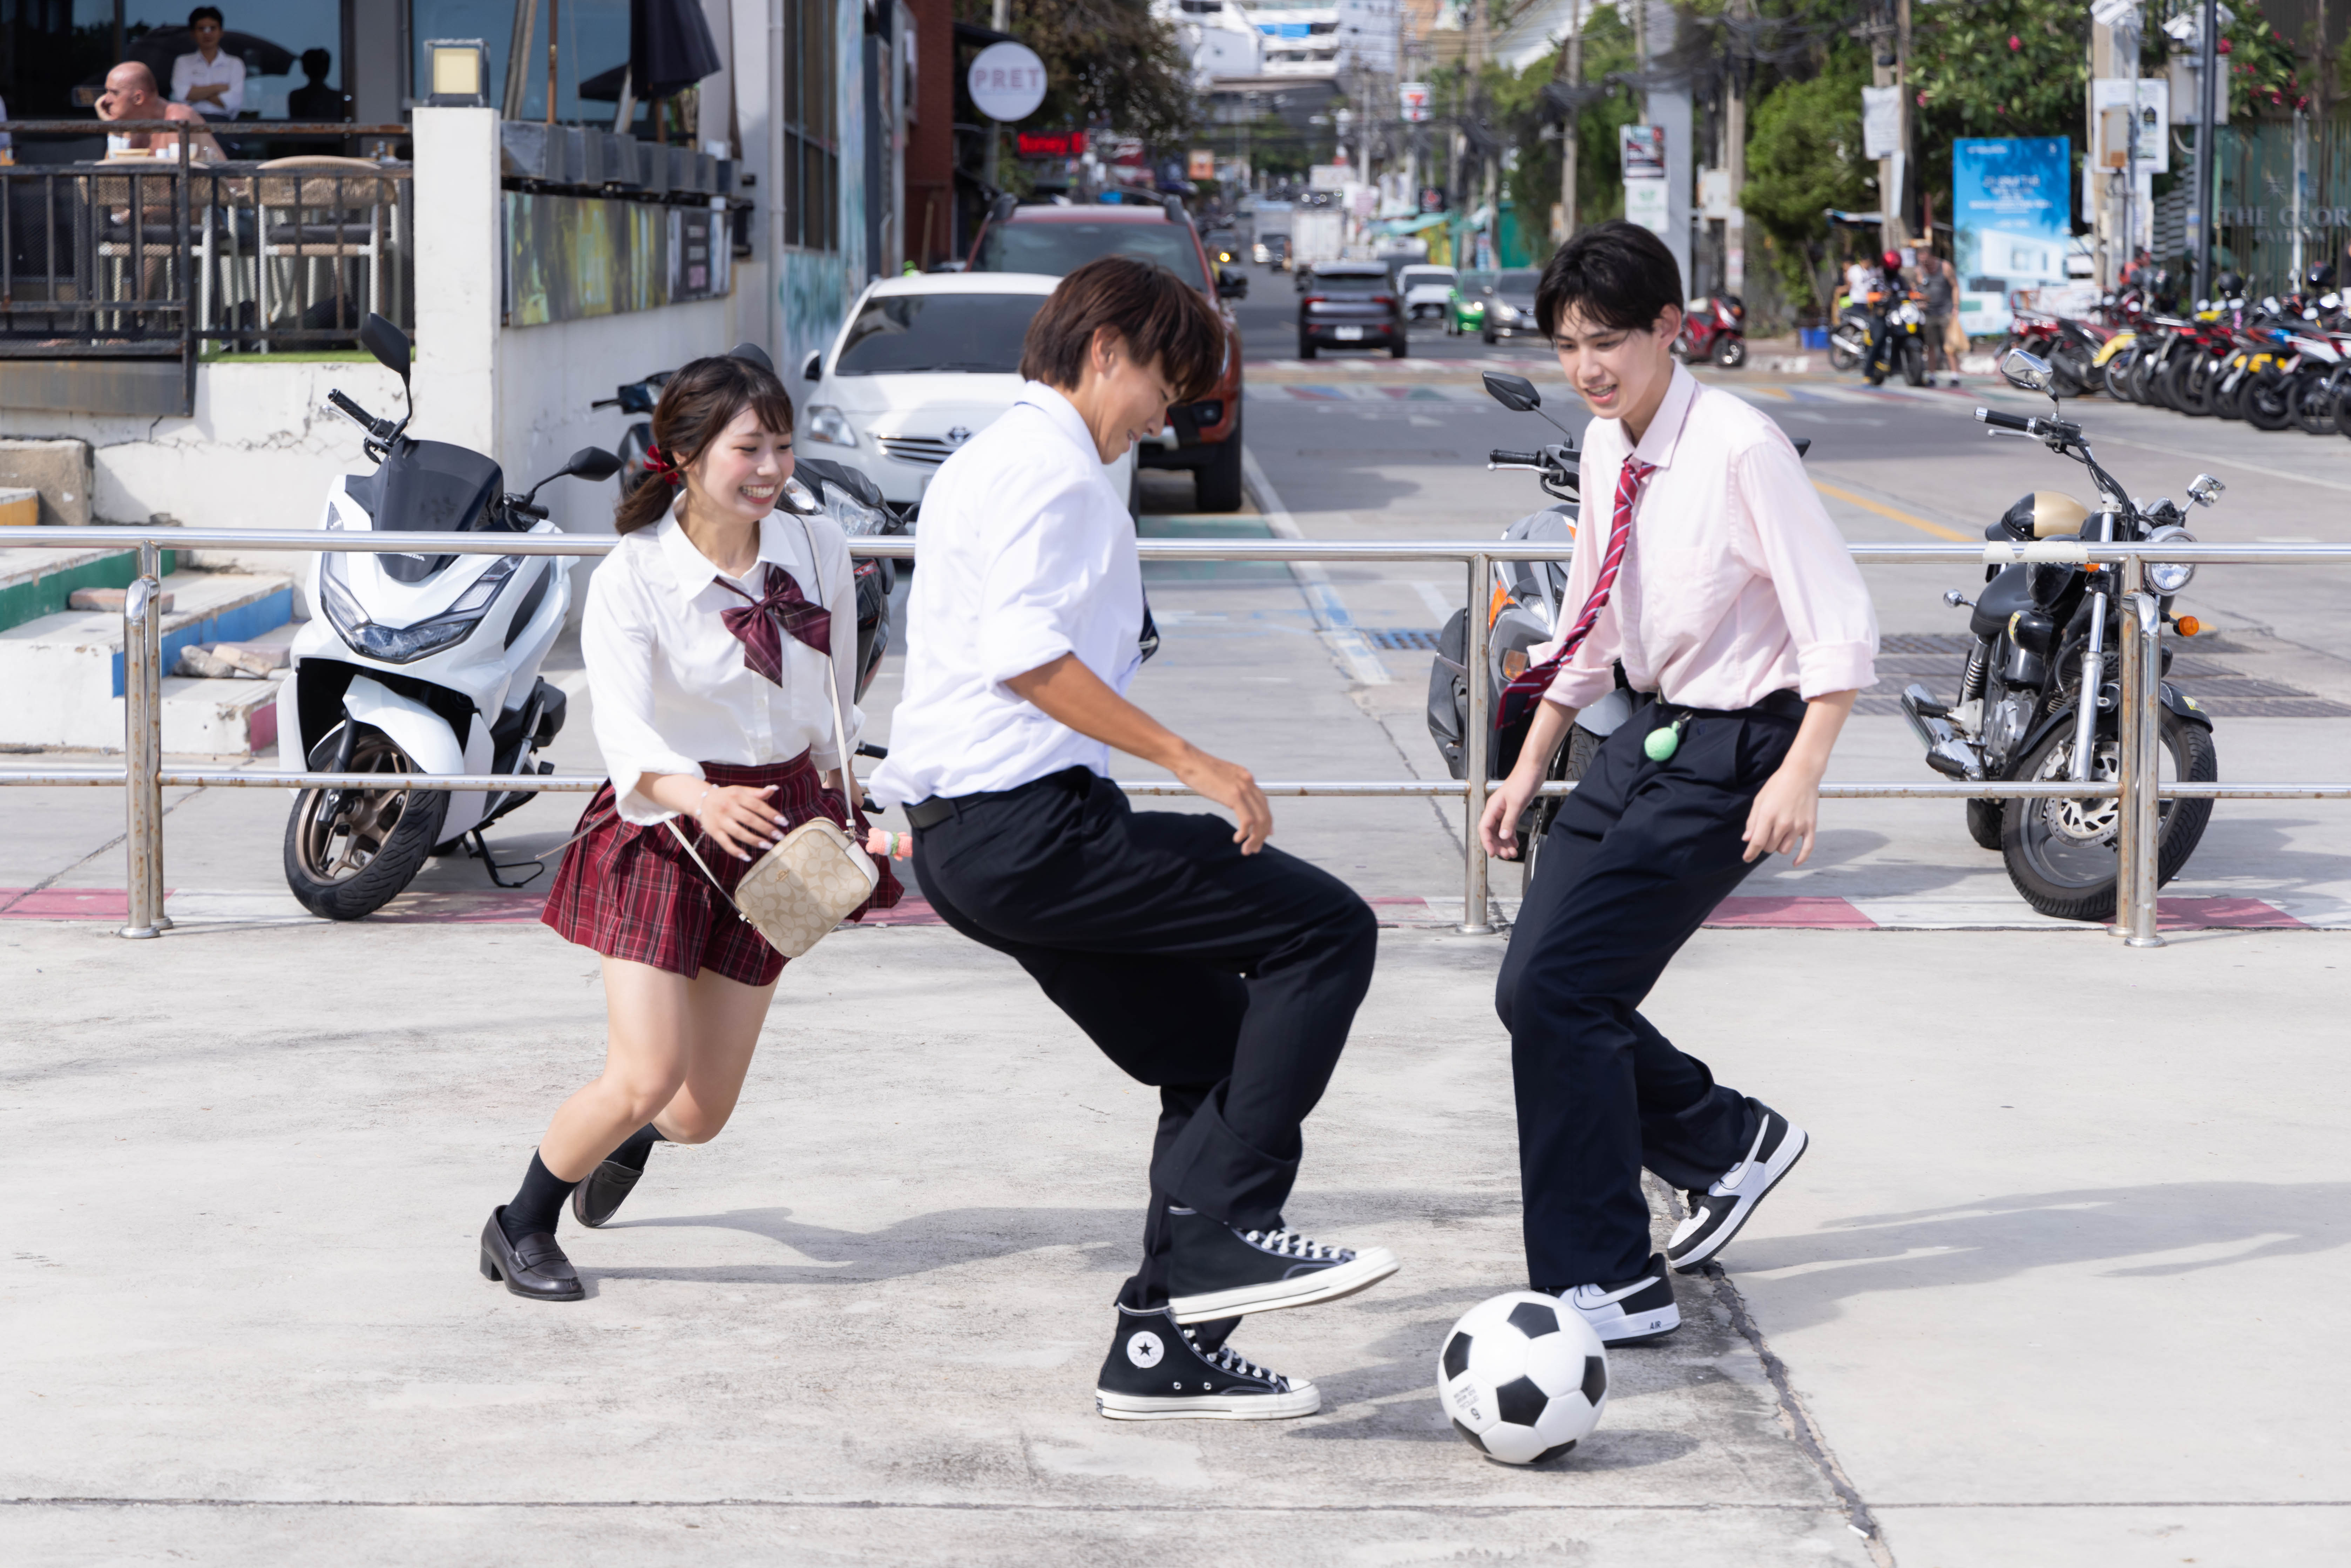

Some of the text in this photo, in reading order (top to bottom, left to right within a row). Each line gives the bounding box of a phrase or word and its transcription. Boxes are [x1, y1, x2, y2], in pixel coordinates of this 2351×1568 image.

[975, 69, 1040, 88] PRET
[2221, 206, 2272, 227] THE
[1649, 1321, 1661, 1330] AIR
